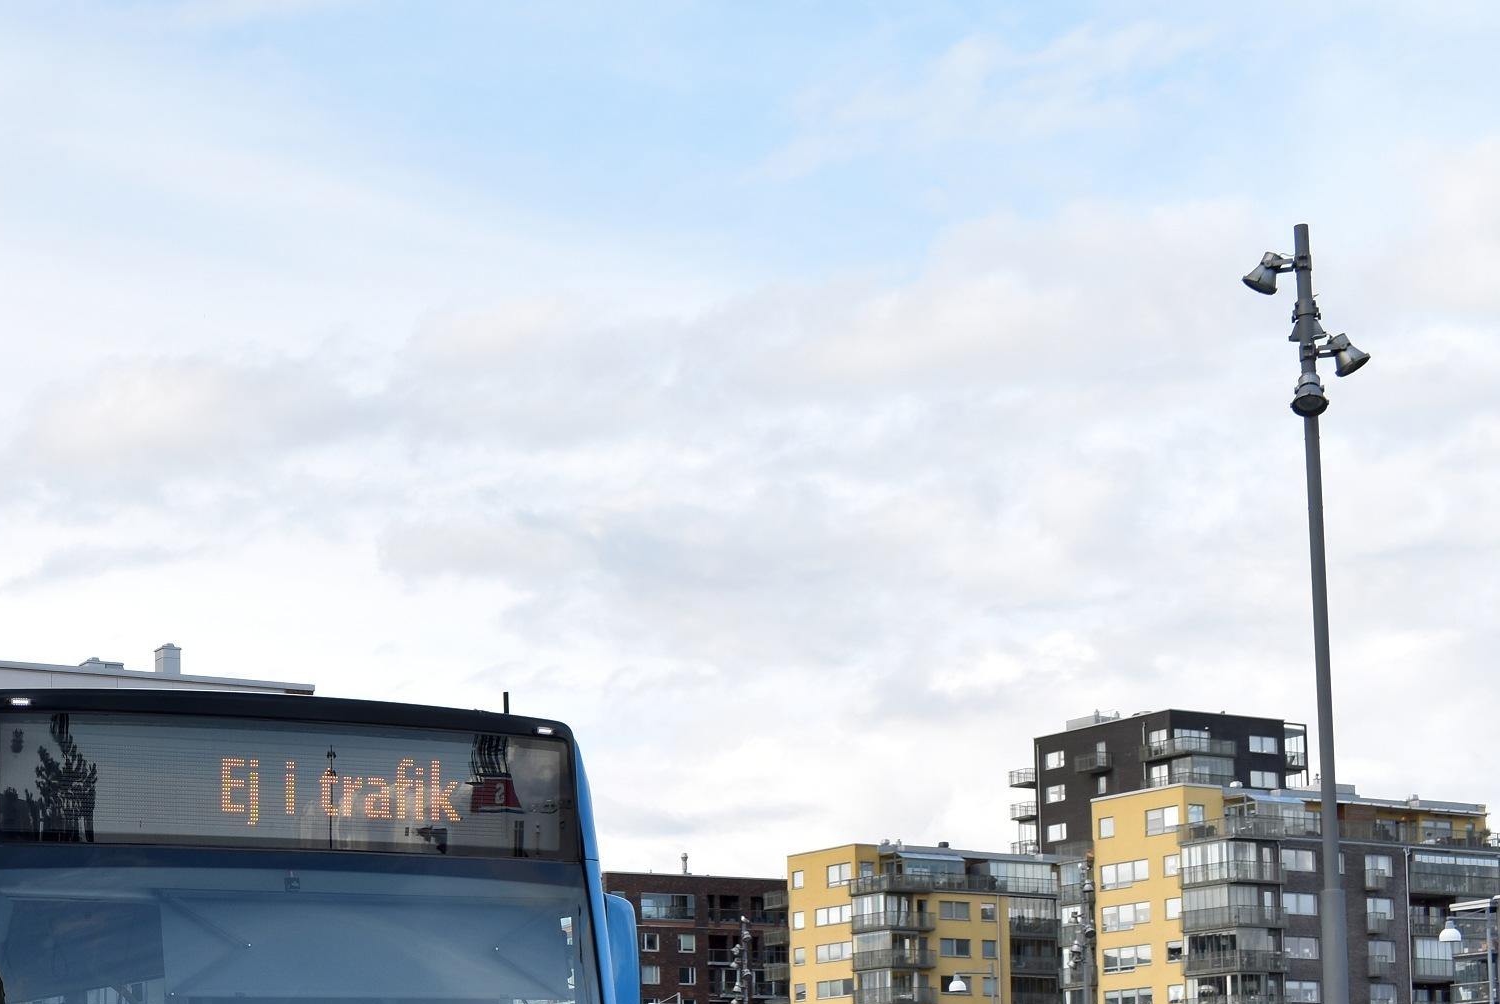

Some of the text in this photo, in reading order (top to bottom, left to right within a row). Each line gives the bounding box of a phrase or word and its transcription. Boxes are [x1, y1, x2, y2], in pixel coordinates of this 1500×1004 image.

[222, 758, 462, 825] Ej i trafik
